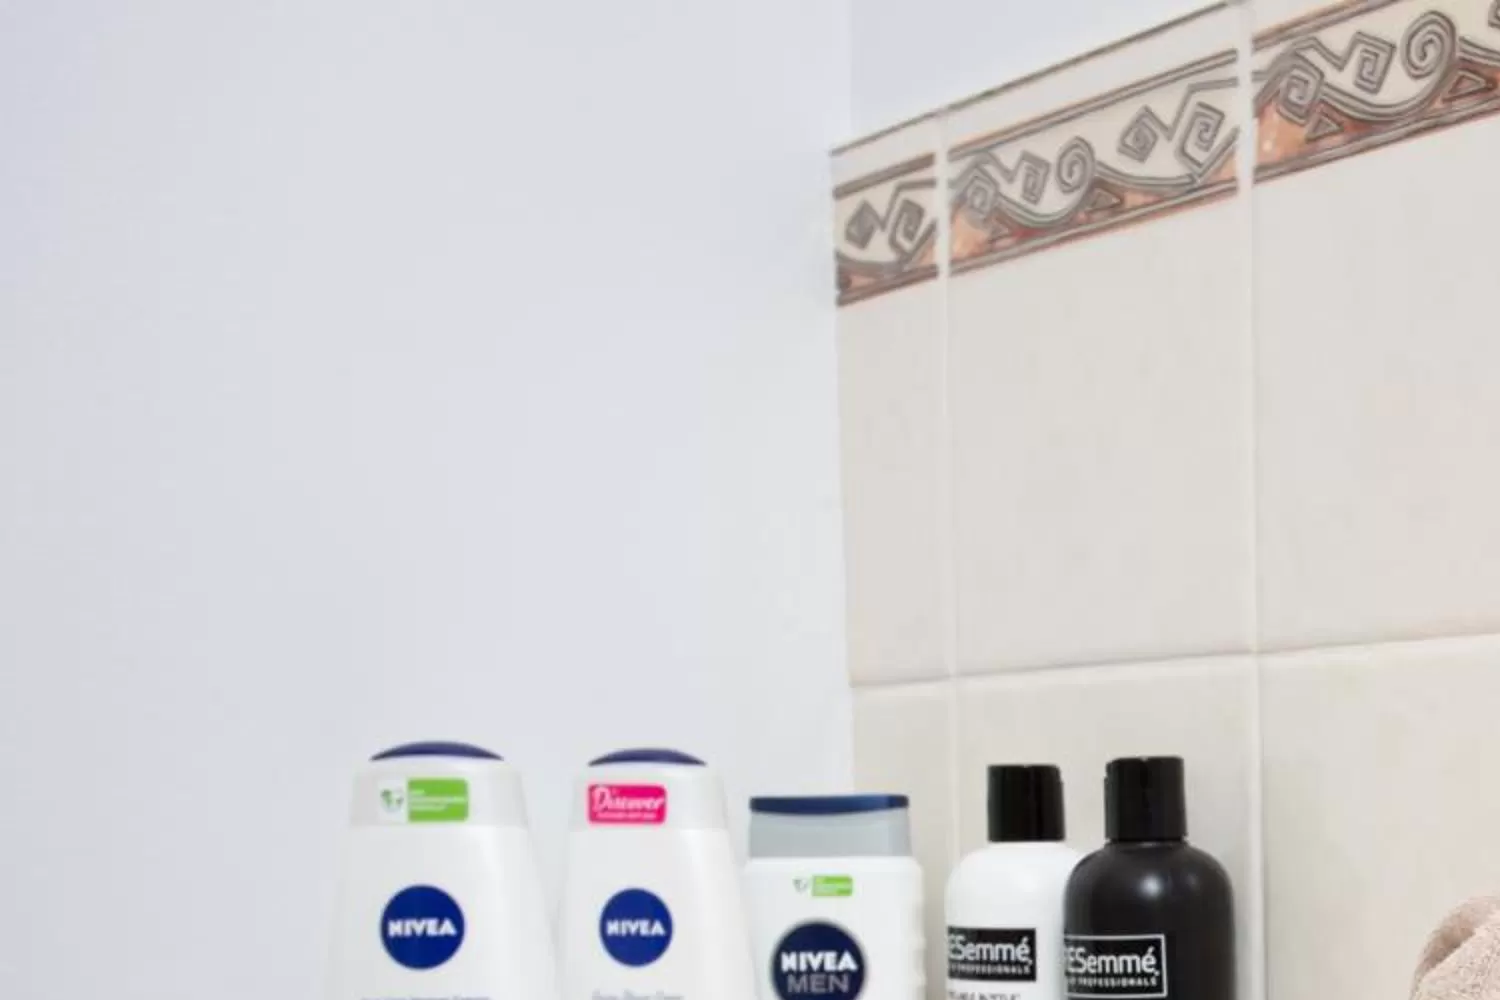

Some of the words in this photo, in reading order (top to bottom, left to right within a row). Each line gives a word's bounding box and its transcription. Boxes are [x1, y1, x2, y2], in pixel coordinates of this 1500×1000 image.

[387, 919, 457, 937] NIVEA
[605, 919, 666, 937] NIVEA
[780, 951, 858, 972] NIVEA
[786, 973, 850, 993] MEN
